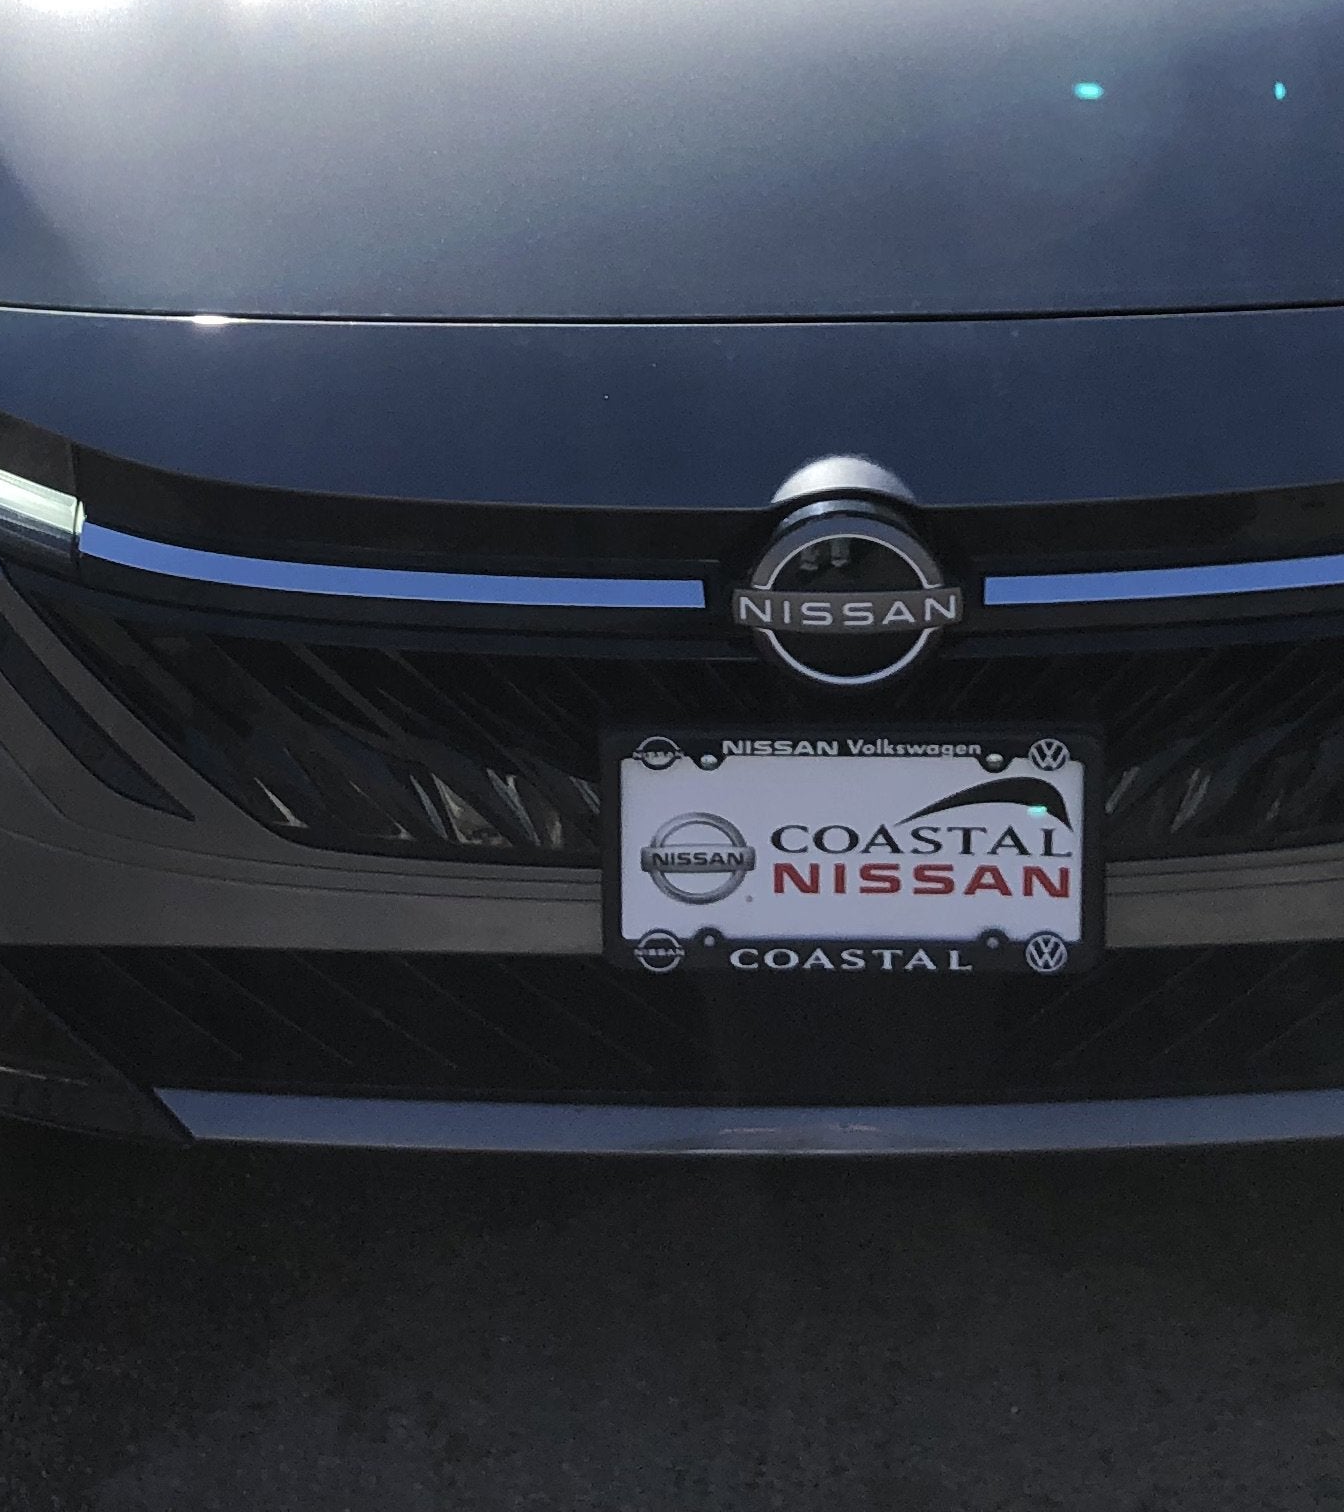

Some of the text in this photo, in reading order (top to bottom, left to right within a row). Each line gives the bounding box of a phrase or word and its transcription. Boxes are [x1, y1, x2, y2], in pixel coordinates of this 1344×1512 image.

[739, 595, 956, 626] NISSAN
[722, 739, 982, 759] NISSAN Volkswagen
[770, 824, 1073, 859] COASTAL
[651, 850, 745, 868] NISSAN
[772, 862, 1070, 898] NISSAN
[729, 948, 973, 971] COASTAL
